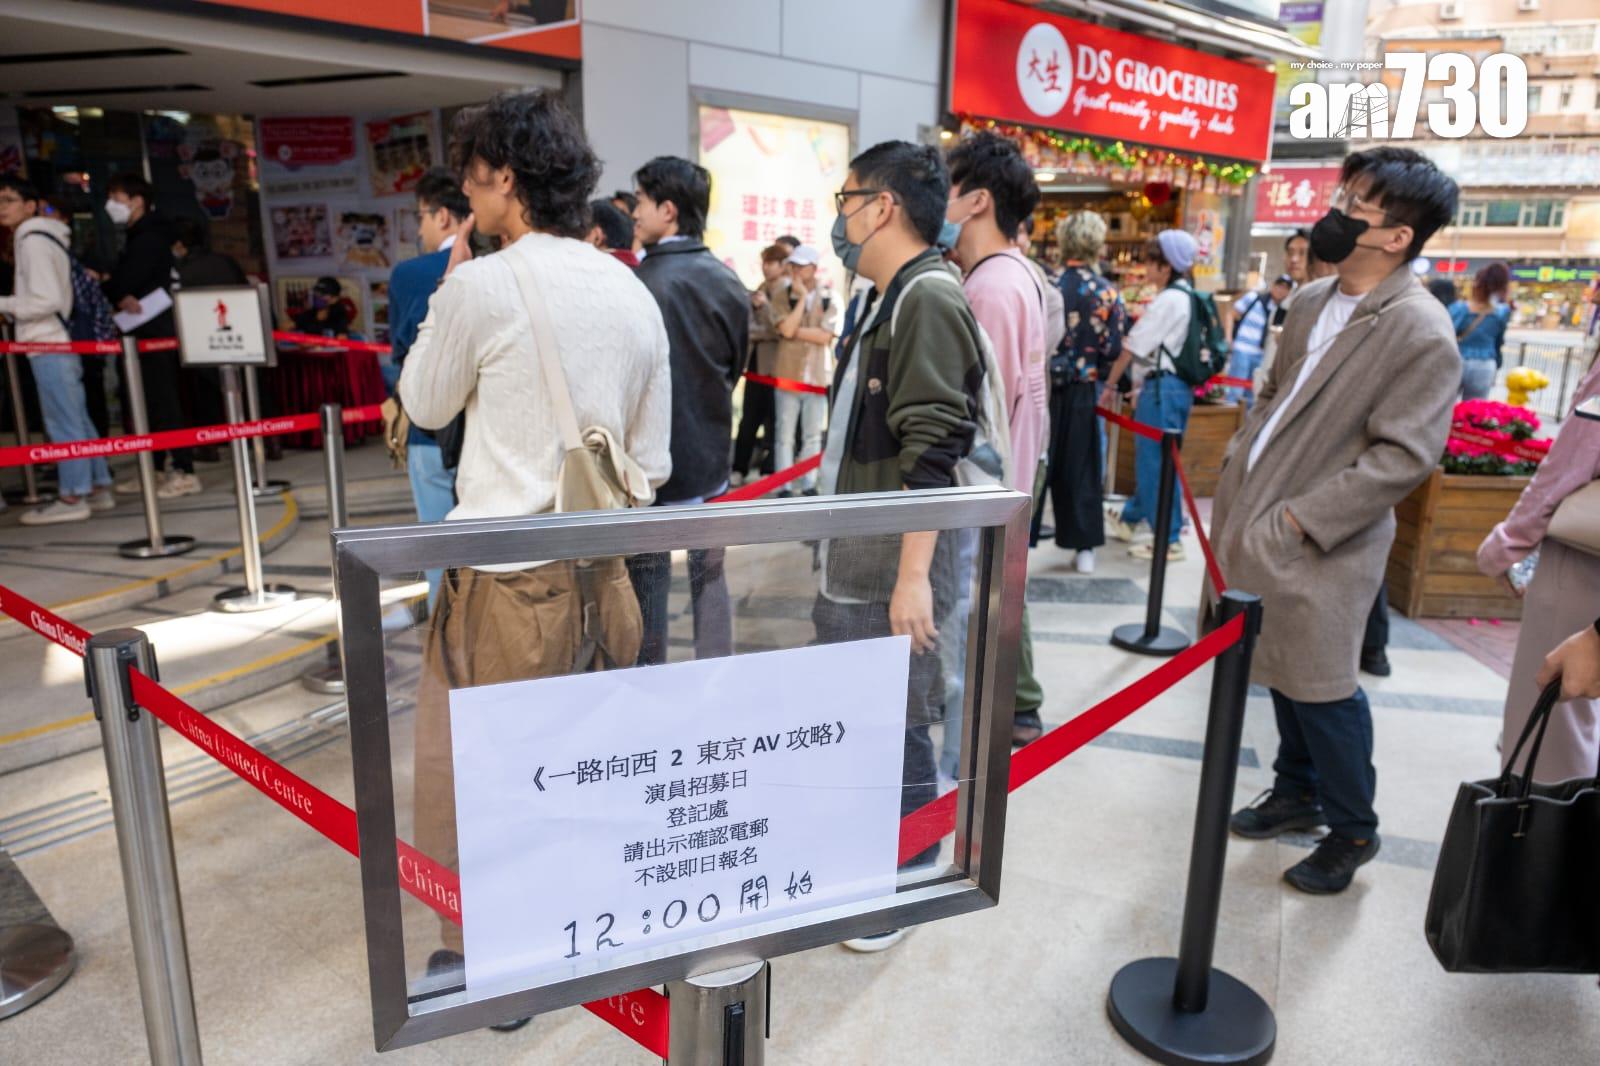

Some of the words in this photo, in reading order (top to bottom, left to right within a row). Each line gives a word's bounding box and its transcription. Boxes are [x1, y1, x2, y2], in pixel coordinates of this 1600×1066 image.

[1027, 49, 1062, 92] 大生
[1076, 44, 1112, 84] DS
[1115, 58, 1238, 111] GROCERIES
[743, 194, 816, 219] 環球食品
[30, 447, 69, 460] China
[71, 441, 112, 455] United
[114, 438, 153, 452] Centre
[196, 429, 228, 441] China
[229, 424, 262, 436] United
[263, 420, 294, 432] Centre
[178, 710, 212, 748] China
[214, 734, 260, 781] United
[262, 766, 313, 815] Centre
[533, 750, 658, 792] 《一路向西
[670, 749, 683, 766] 2
[696, 737, 746, 765] 東京
[752, 733, 780, 753] AV
[785, 720, 846, 751] 攻略》
[644, 769, 748, 805] 演員招募日
[666, 800, 729, 828] 登記處
[624, 817, 769, 863] 請出示確認電郵
[398, 855, 460, 913] China
[634, 846, 759, 887] 不設即日報名
